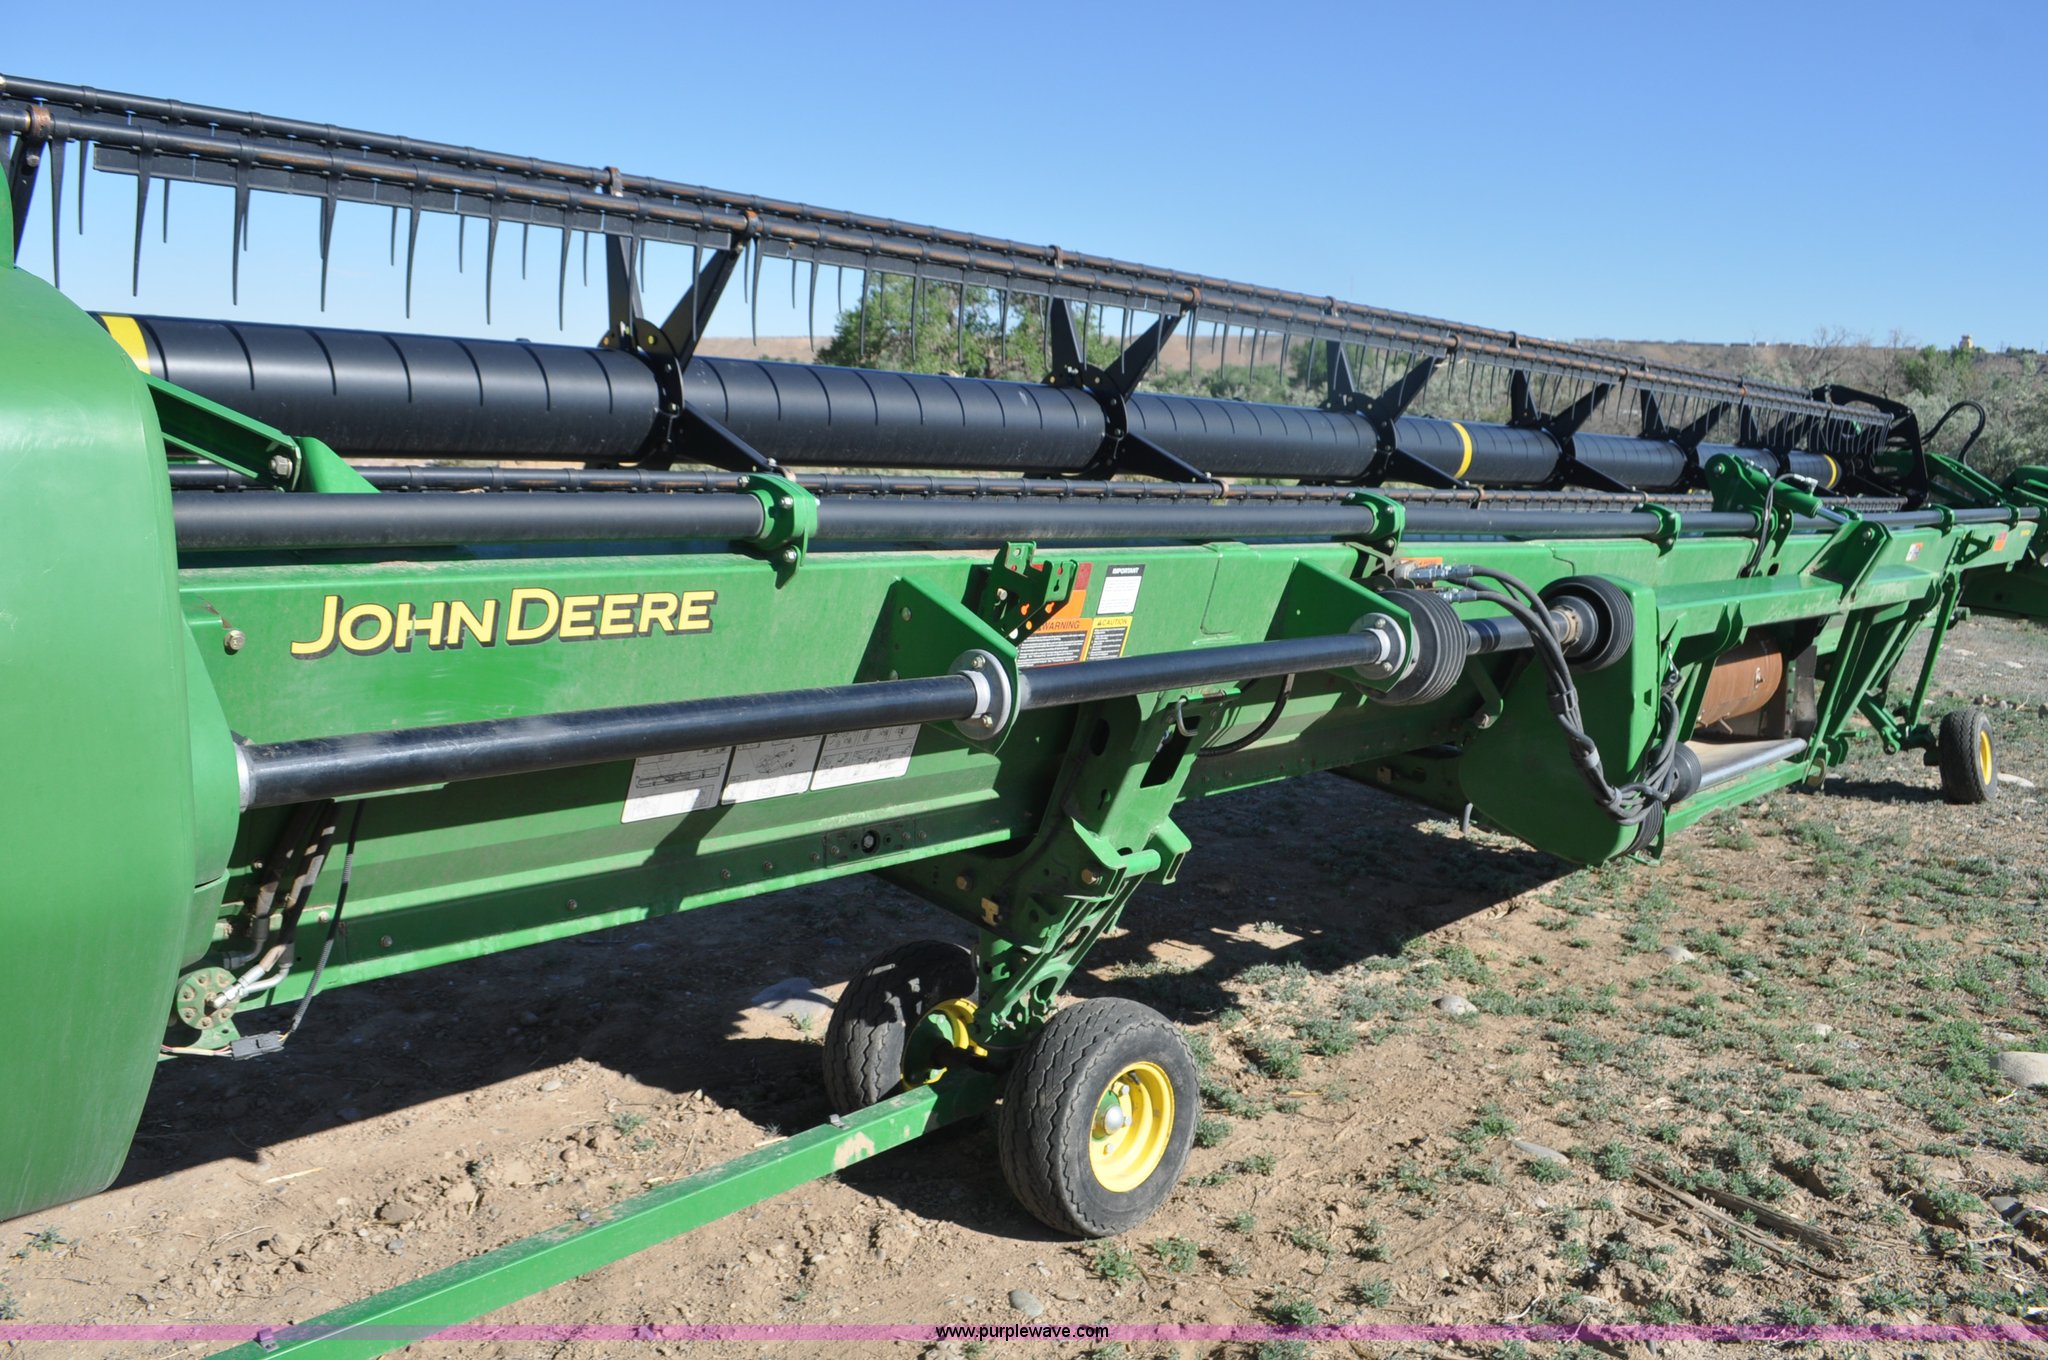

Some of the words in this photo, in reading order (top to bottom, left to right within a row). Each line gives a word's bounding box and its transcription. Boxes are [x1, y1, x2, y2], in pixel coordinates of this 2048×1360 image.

[290, 594, 501, 660] JOHN
[505, 587, 719, 647] DEERE
[1043, 620, 1081, 630] WARNING
[1101, 618, 1128, 626] CAUTION
